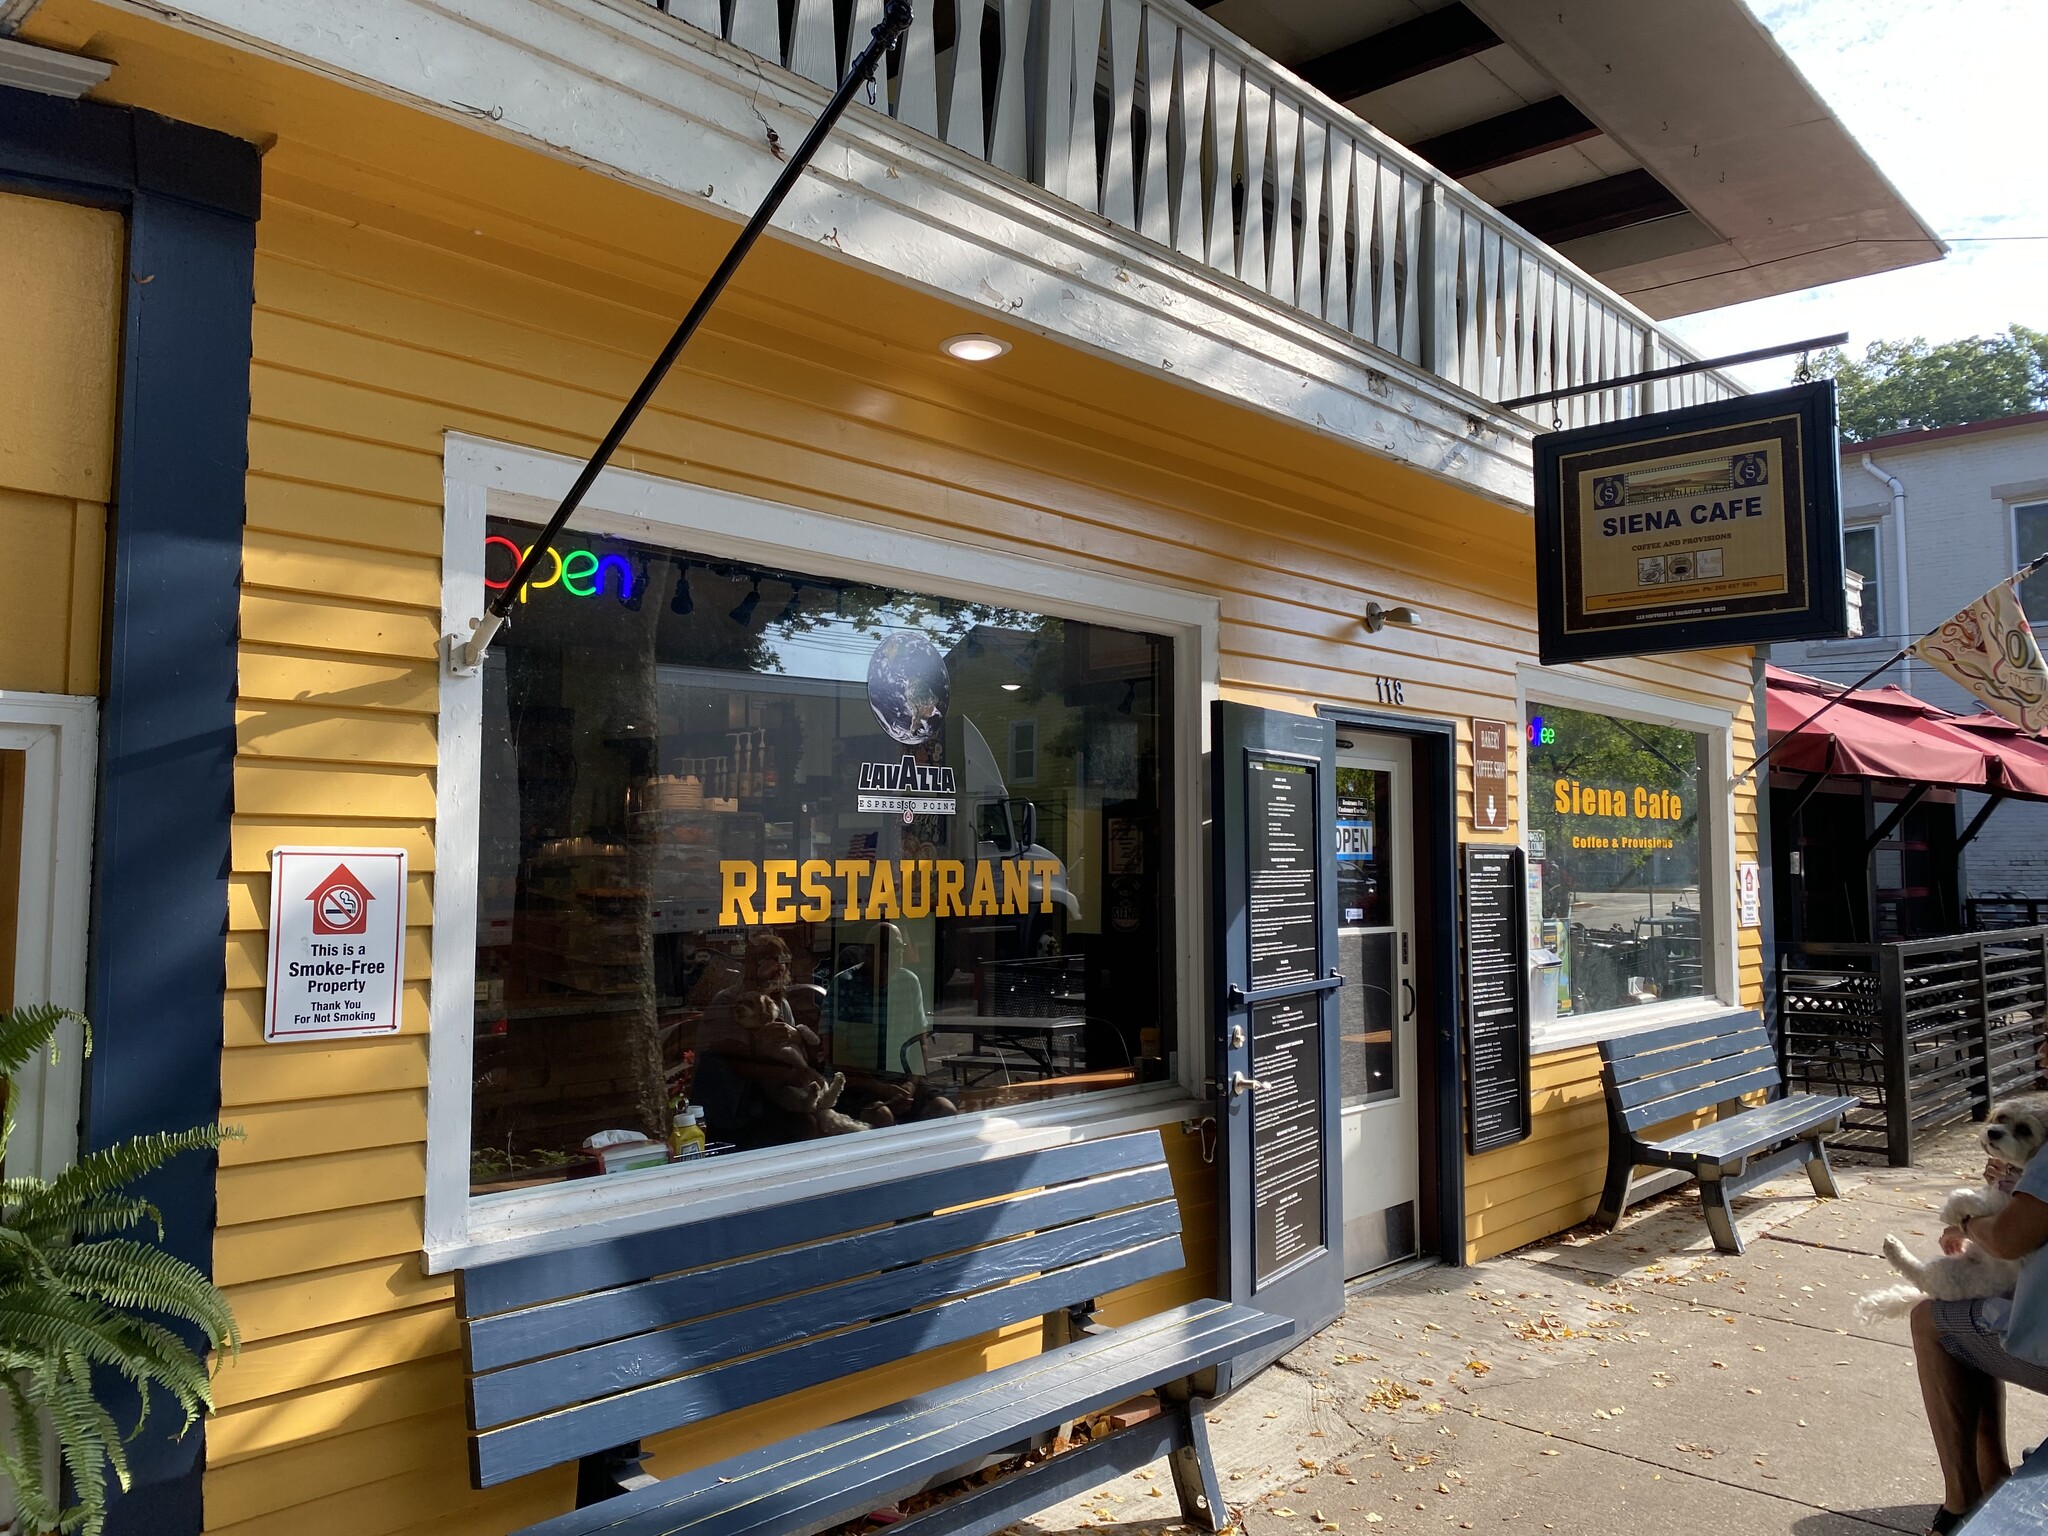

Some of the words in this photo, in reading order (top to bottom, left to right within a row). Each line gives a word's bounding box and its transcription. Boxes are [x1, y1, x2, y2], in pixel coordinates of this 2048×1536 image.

[1602, 508, 1682, 537] SIENA
[1690, 496, 1762, 524] CAFE
[1631, 542, 1662, 551] COFFEE
[1664, 539, 1680, 547] AND
[1682, 533, 1732, 546] PROVISIONS
[485, 536, 632, 604] Open
[1376, 676, 1405, 705] 118
[1480, 728, 1501, 749] BAKERY
[858, 755, 956, 793] LAVAZZA
[1476, 760, 1494, 778] COFFEE
[1494, 760, 1506, 779] SHOP
[859, 800, 916, 811] ESPRESSO
[923, 802, 956, 811] POINT
[1554, 778, 1627, 818] Siena
[1634, 786, 1682, 820] Cafe
[1336, 828, 1369, 853] OPEN
[1572, 836, 1609, 848] Coffee
[1611, 837, 1619, 848] &
[1621, 837, 1673, 849] Provisions
[718, 859, 1061, 927] RESTAURANT
[311, 943, 339, 957] This
[343, 943, 354, 956] is
[358, 944, 366, 955] a
[289, 960, 385, 977] Smoke-Free
[308, 978, 366, 994] Property
[311, 1000, 341, 1012] Thank
[344, 1000, 361, 1010] You
[294, 1014, 311, 1024] For
[314, 1013, 331, 1024] Not
[333, 1011, 375, 1022] Smoking
